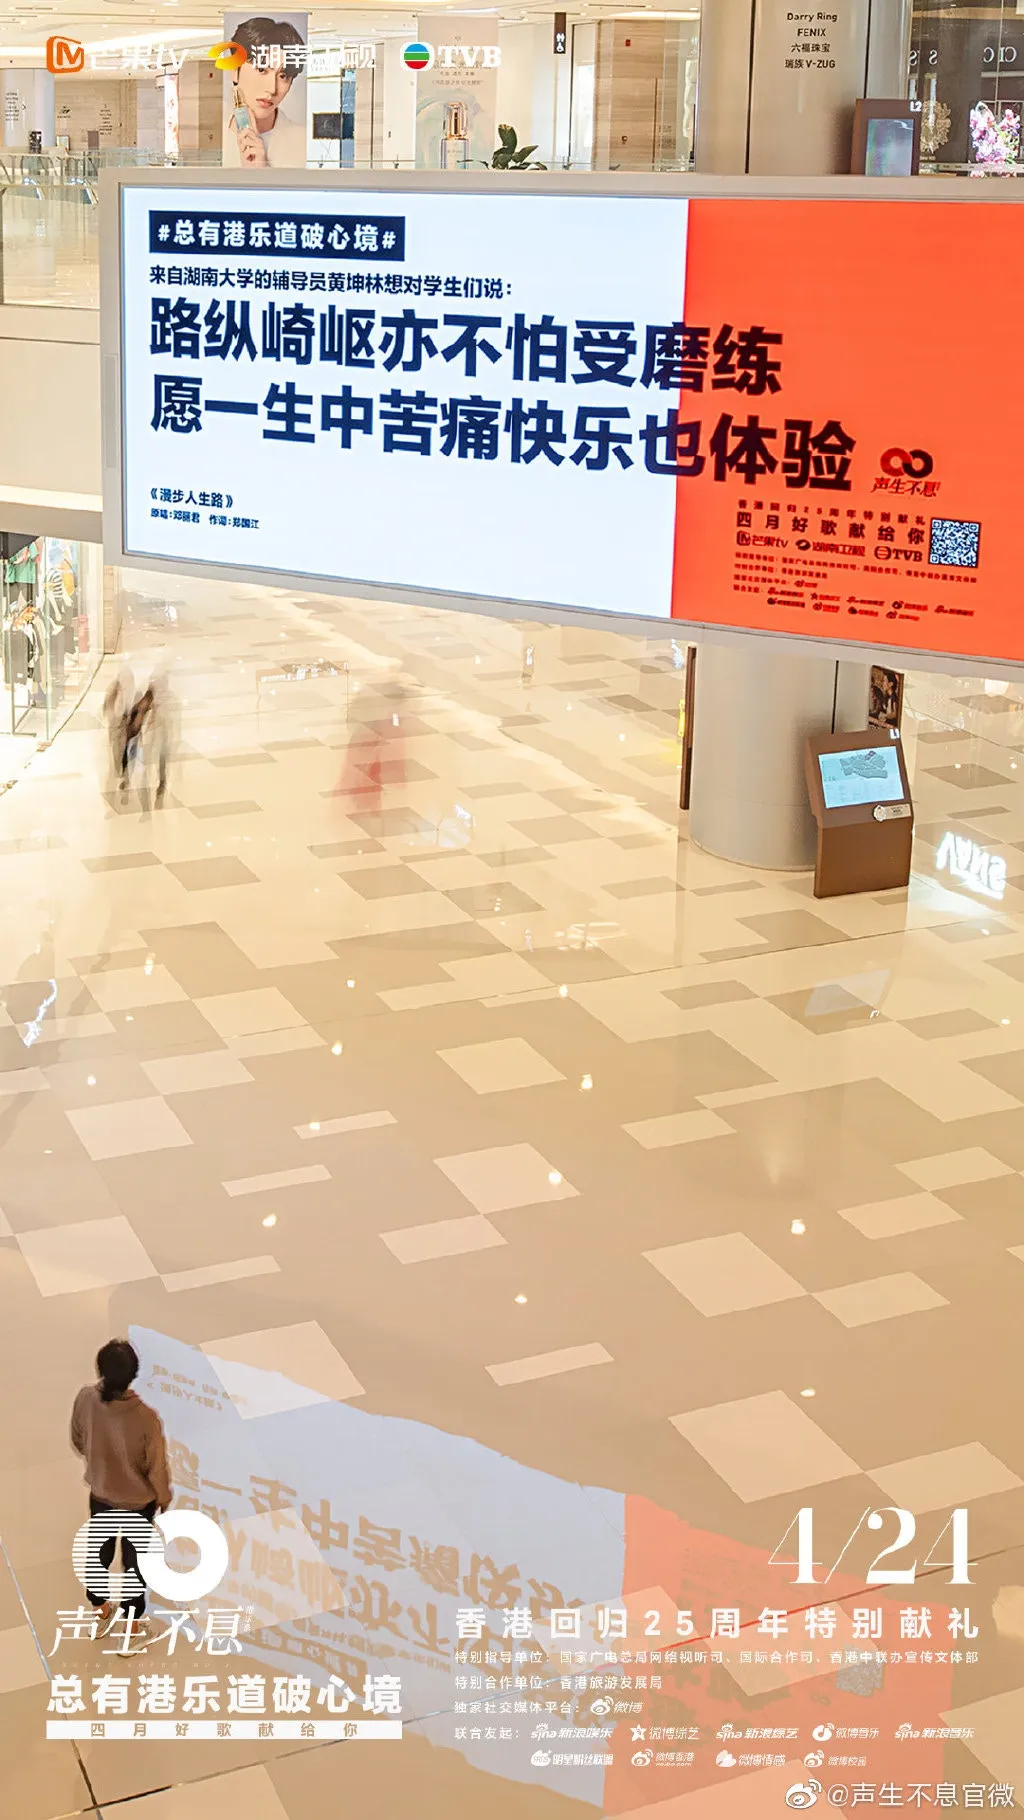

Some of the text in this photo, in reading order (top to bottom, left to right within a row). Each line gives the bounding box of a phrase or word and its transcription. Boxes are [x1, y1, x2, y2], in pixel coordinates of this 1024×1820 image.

[787, 12, 838, 22] Darry Ring
[797, 28, 826, 37] FENIX
[806, 60, 836, 69] V-ZUG
[157, 219, 397, 253] #总有港乐道破心境#
[149, 264, 513, 300] 来自湖南大学的辅导员黄坤林想对学生们说：
[149, 296, 783, 396] 路纵崎岖亦不怕受磨练
[150, 374, 857, 492] 愿一生中苦痛快乐也体验
[150, 487, 233, 508] 《漫步人生路》
[870, 477, 938, 497] 声生不息
[736, 511, 925, 545] 四月好歌献给你
[892, 549, 923, 562] TVB
